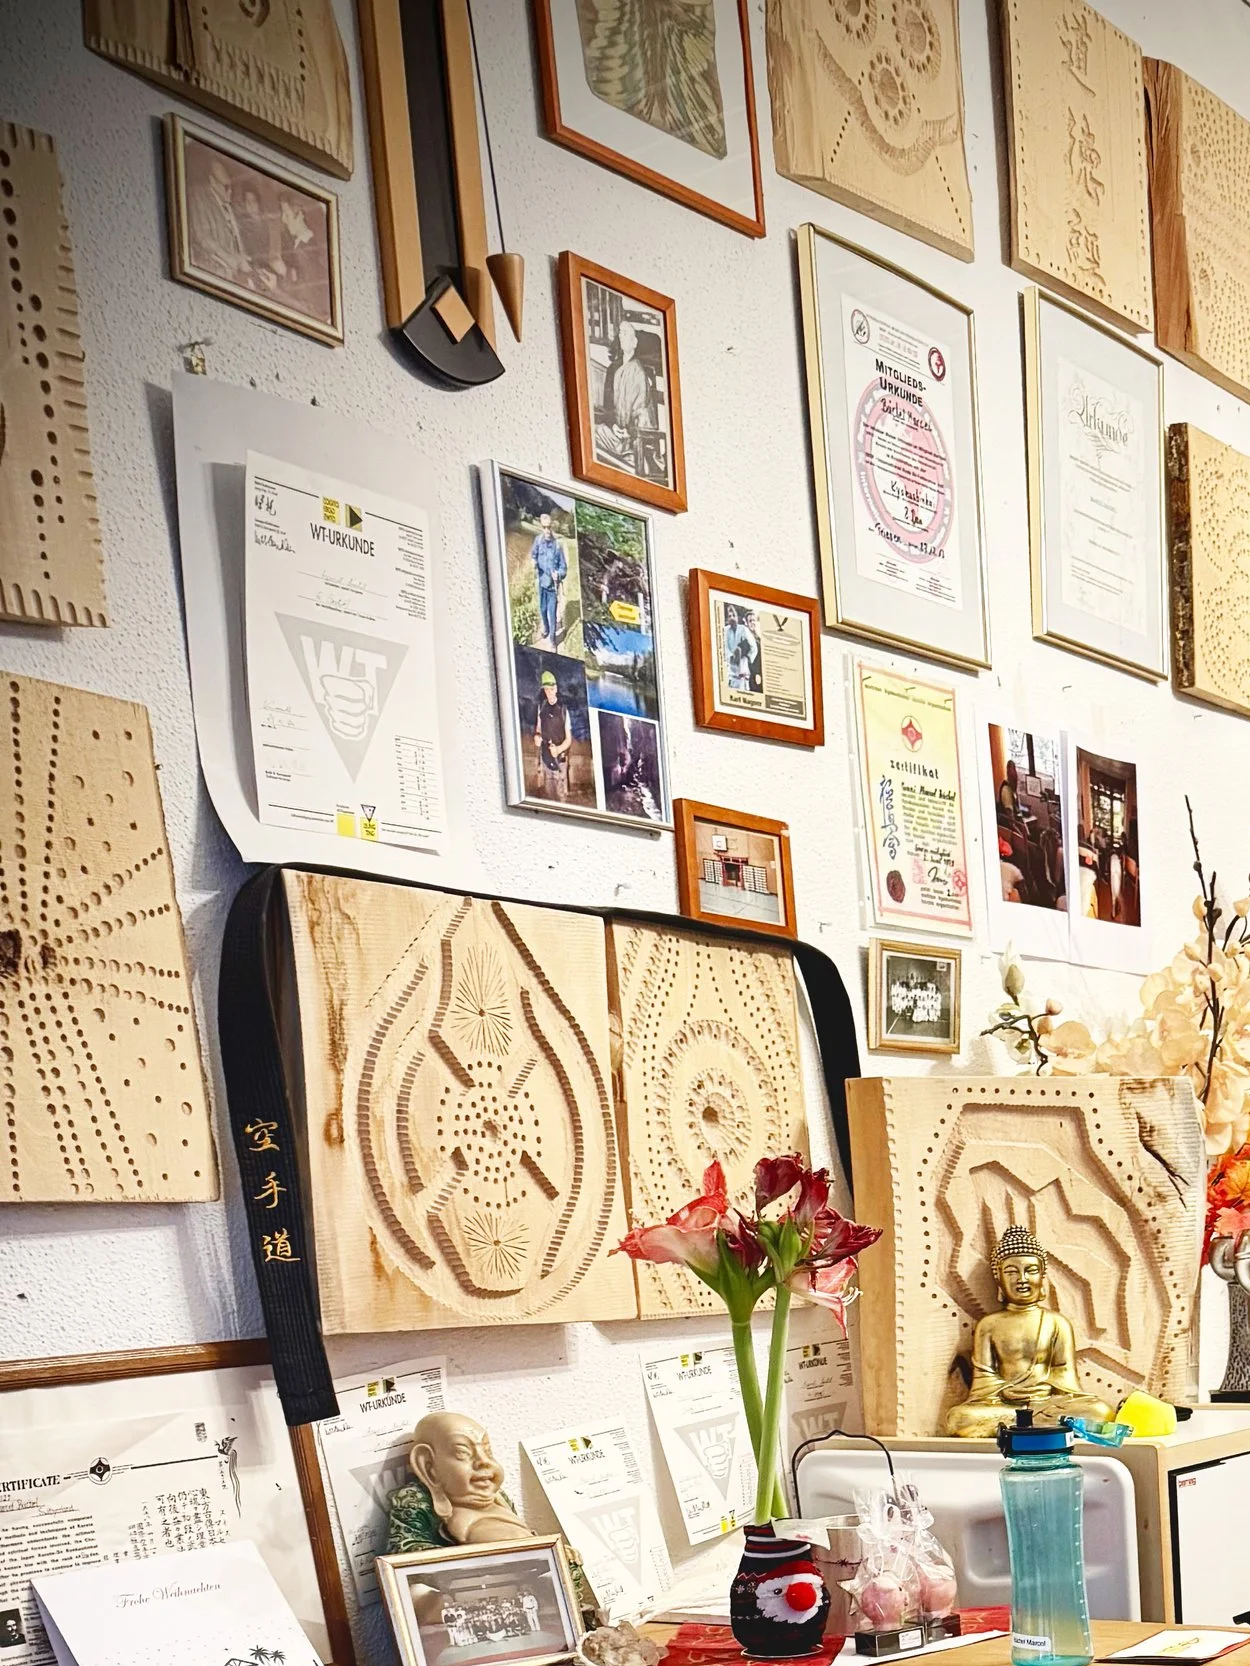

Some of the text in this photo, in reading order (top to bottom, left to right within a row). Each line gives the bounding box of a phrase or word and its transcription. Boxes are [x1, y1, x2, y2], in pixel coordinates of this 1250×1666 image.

[878, 376, 924, 408] URKUNDE
[309, 522, 376, 557] WT-URKUNDE
[244, 1117, 301, 1263] 空手道
[676, 1365, 713, 1382] WT-URKUNDE
[359, 1392, 407, 1414] WT-URKUNDE
[567, 1449, 606, 1465] WT-URKUNDE
[0, 1474, 61, 1493] RTIFICATE
[115, 1582, 222, 1609] Frohe Weihnachten
